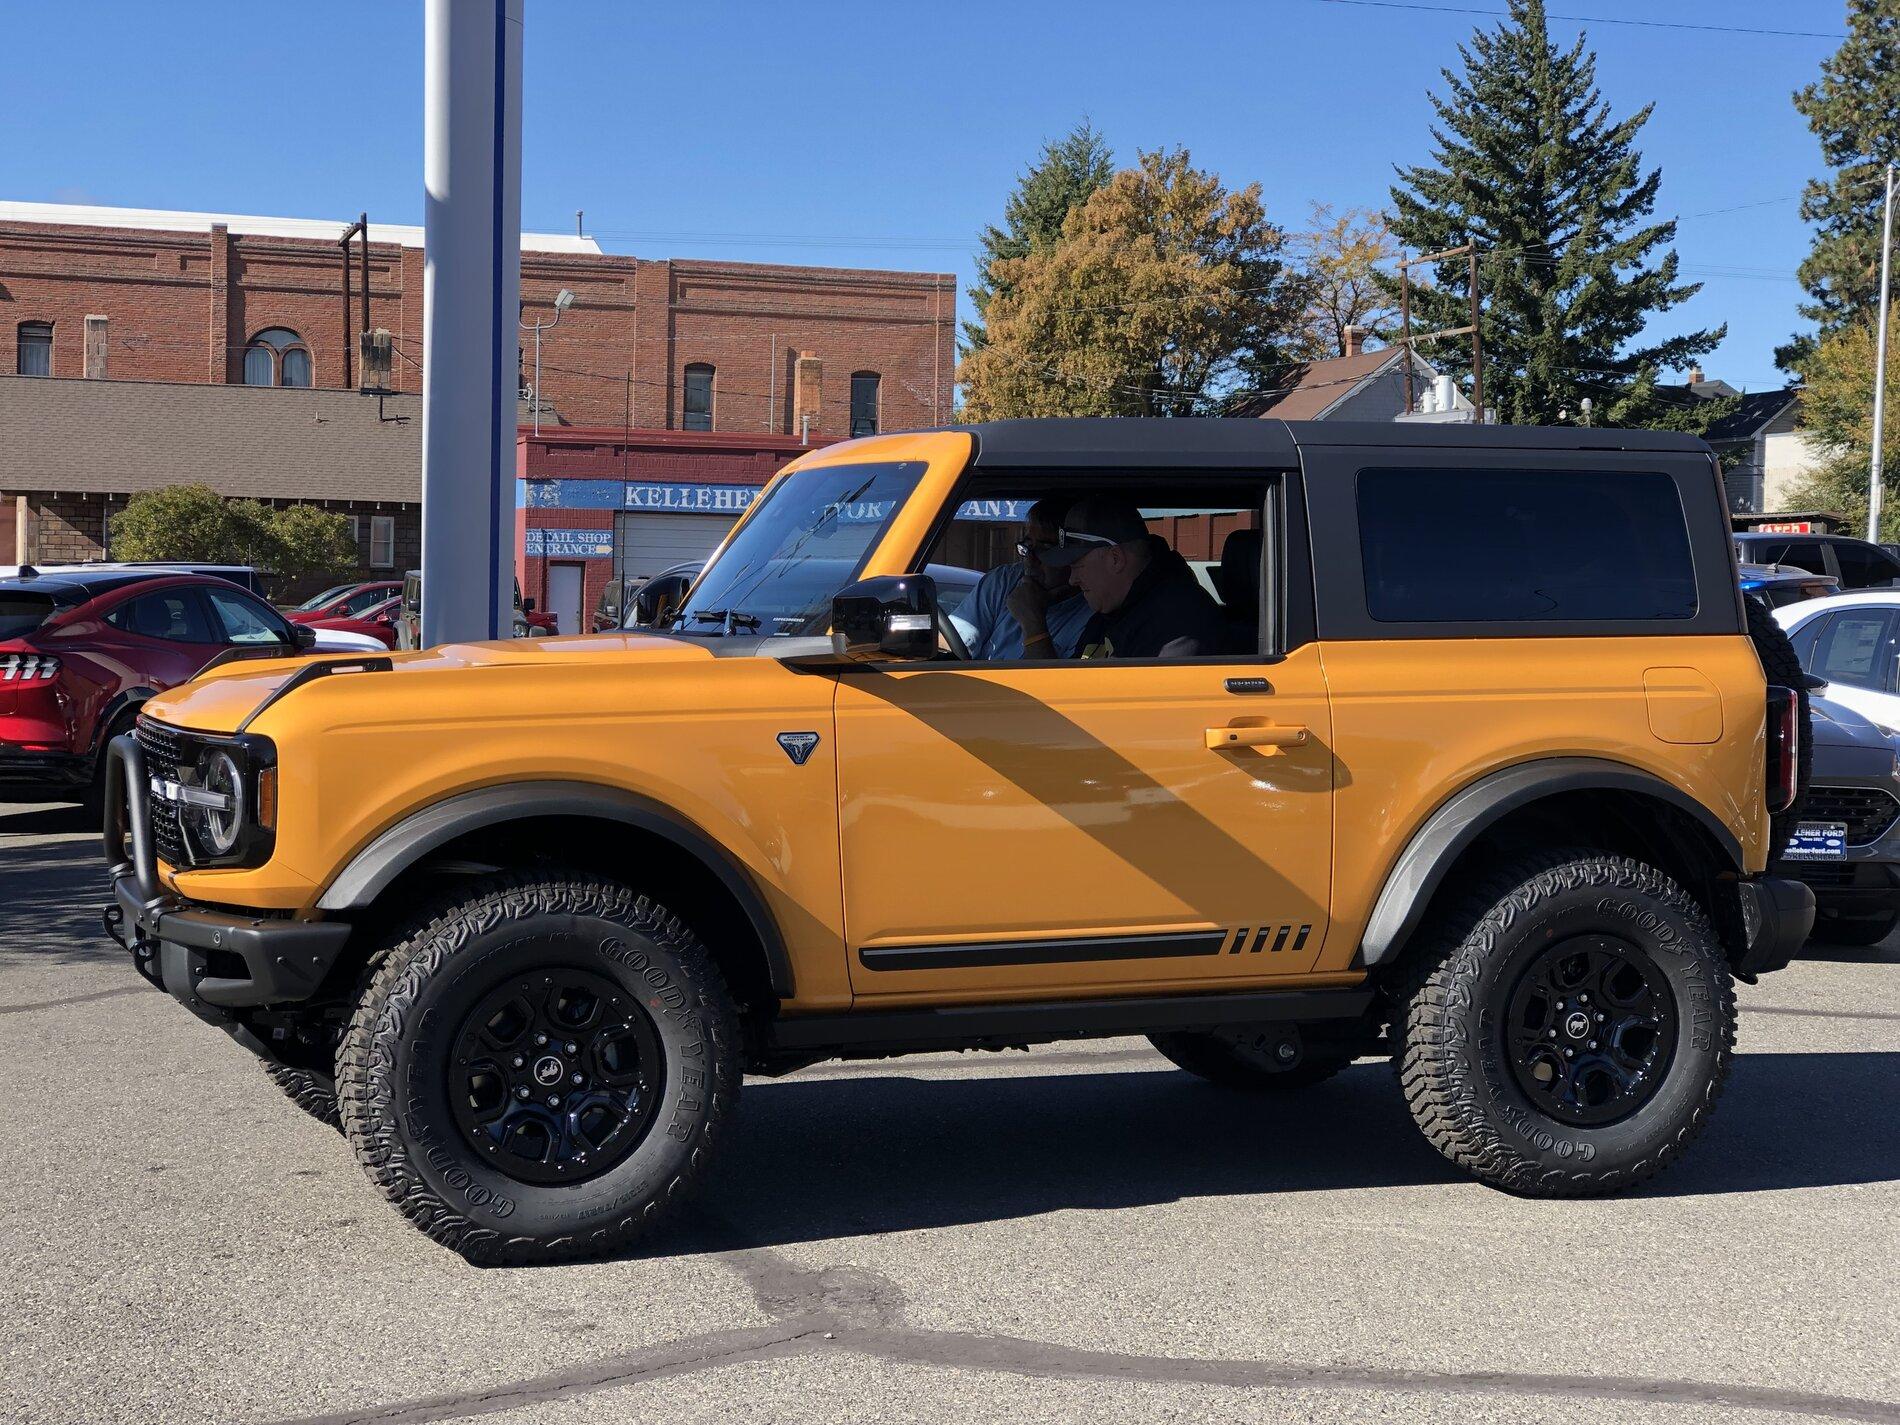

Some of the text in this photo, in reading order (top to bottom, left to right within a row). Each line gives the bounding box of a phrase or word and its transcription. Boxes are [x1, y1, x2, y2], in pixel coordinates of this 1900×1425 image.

[625, 486, 760, 509] KELLEHE
[526, 532, 611, 543] DETAIL SHOP
[526, 543, 595, 555] ENTRANCE
